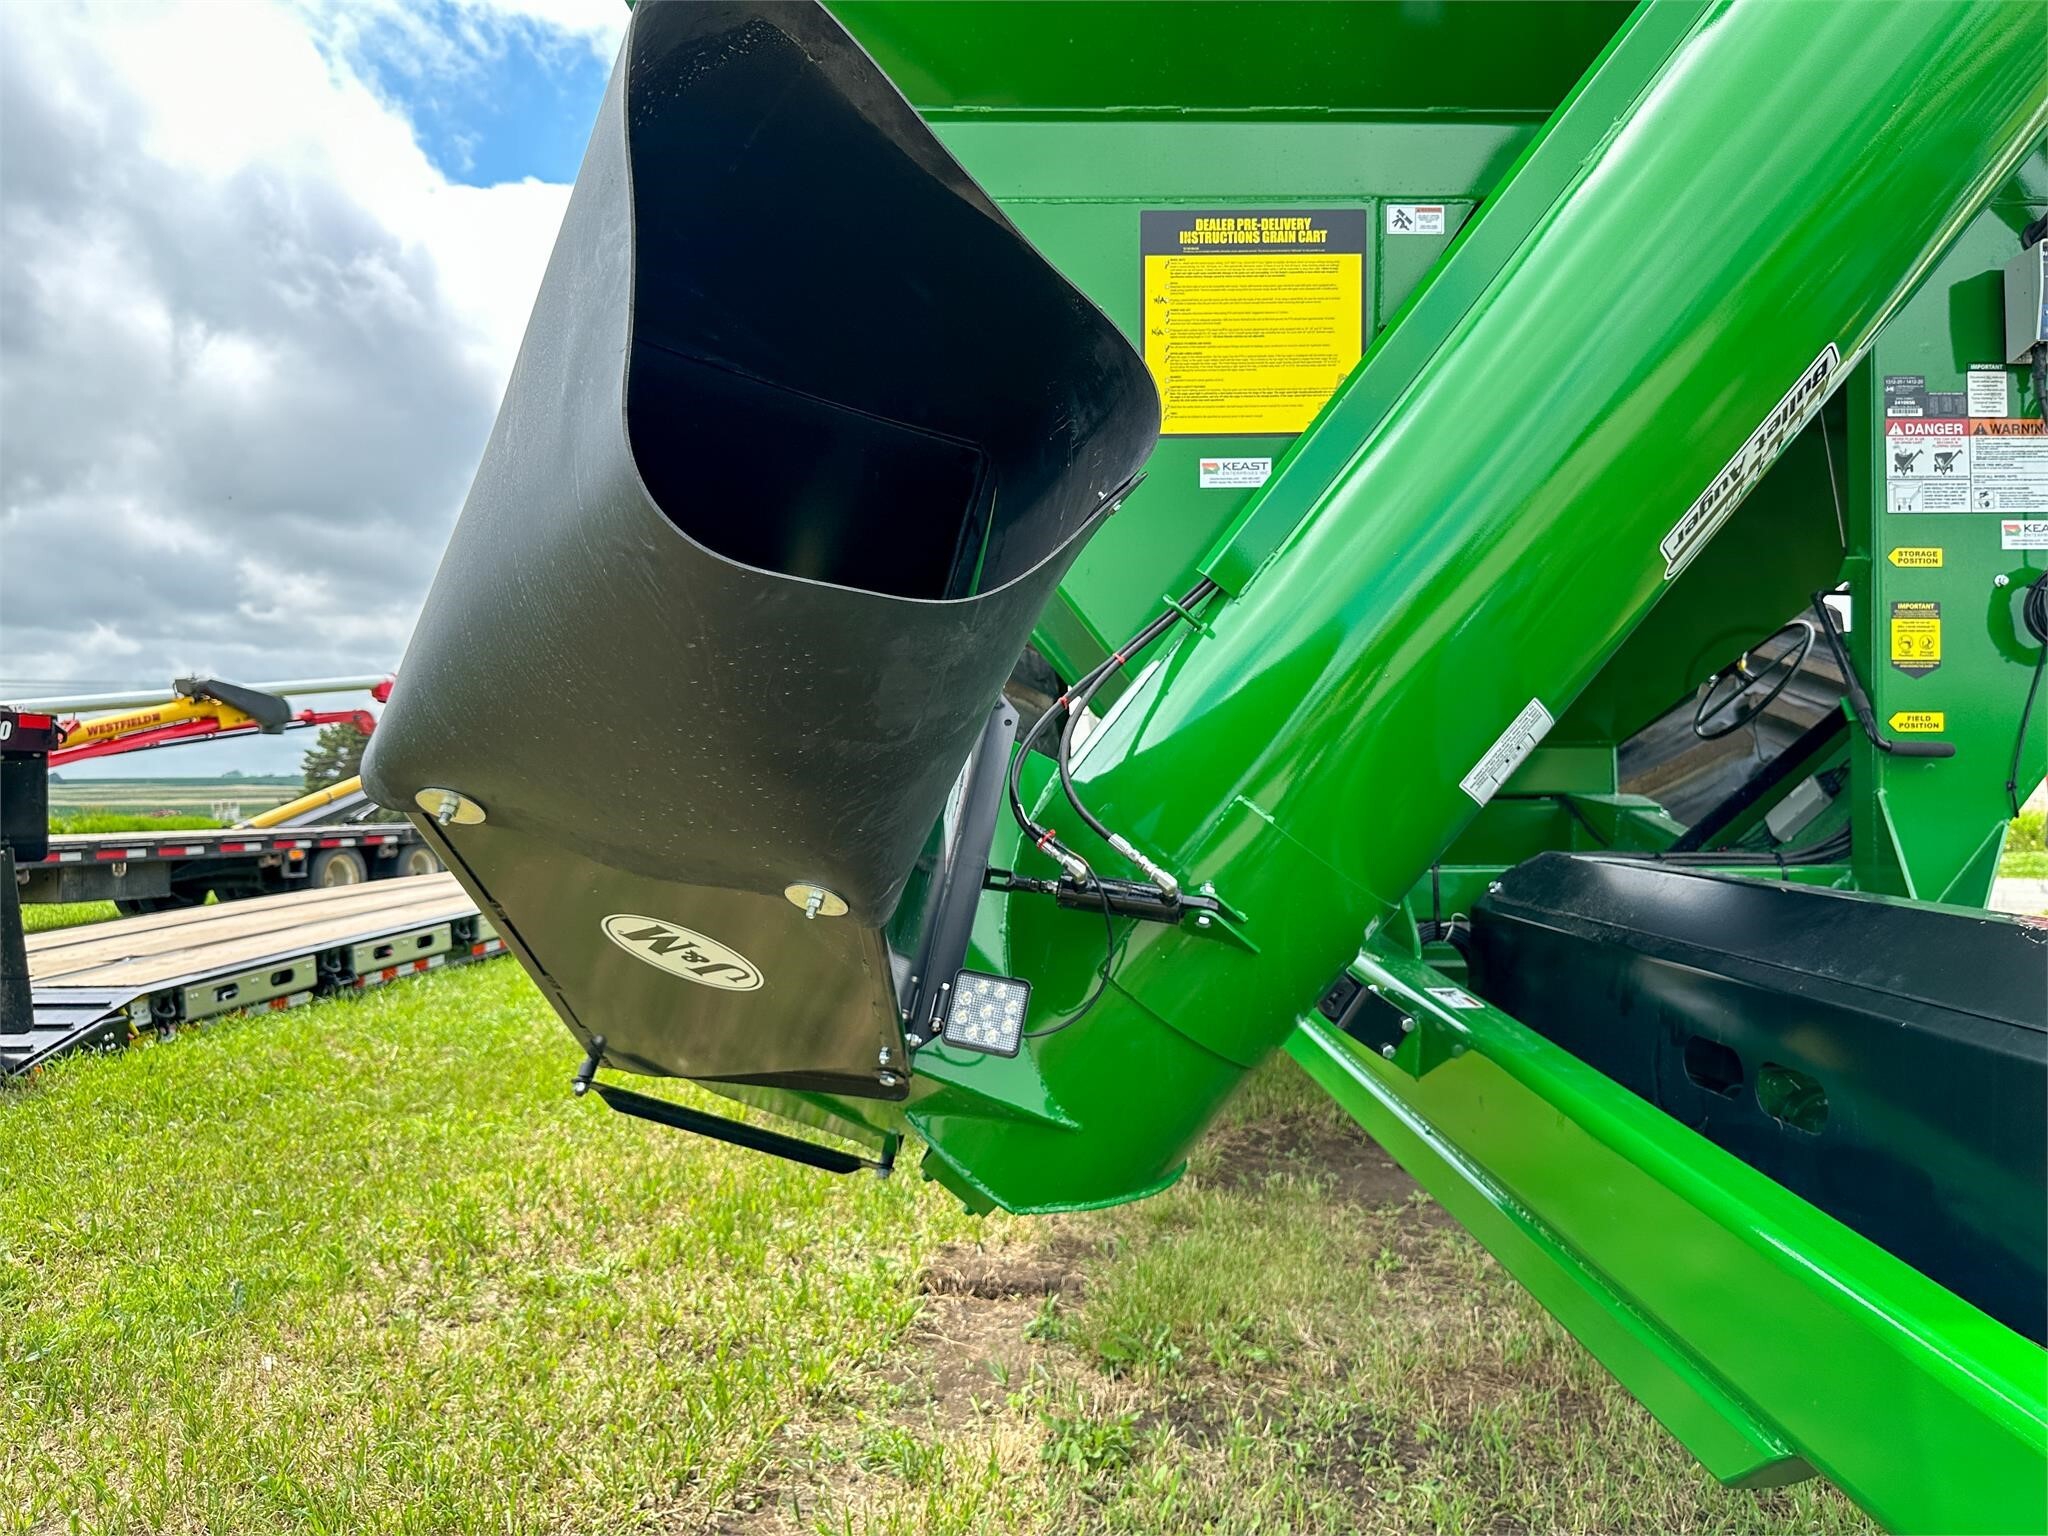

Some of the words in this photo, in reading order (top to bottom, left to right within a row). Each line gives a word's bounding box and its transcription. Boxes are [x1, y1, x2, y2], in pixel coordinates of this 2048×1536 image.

[1195, 218, 1235, 231] DEALER
[1236, 217, 1312, 231] PRE-DELIVERY
[1179, 231, 1260, 244] INSTRUCTIONS
[1262, 231, 1296, 243] GRAIN
[1298, 230, 1328, 243] CART
[1754, 357, 1829, 453] Bullet
[1905, 423, 1964, 435] DANGER
[1222, 462, 1269, 471] KEAST
[1673, 453, 1748, 550] Auger
[86, 714, 153, 737] WESTFIELD
[618, 924, 751, 984] J&M
